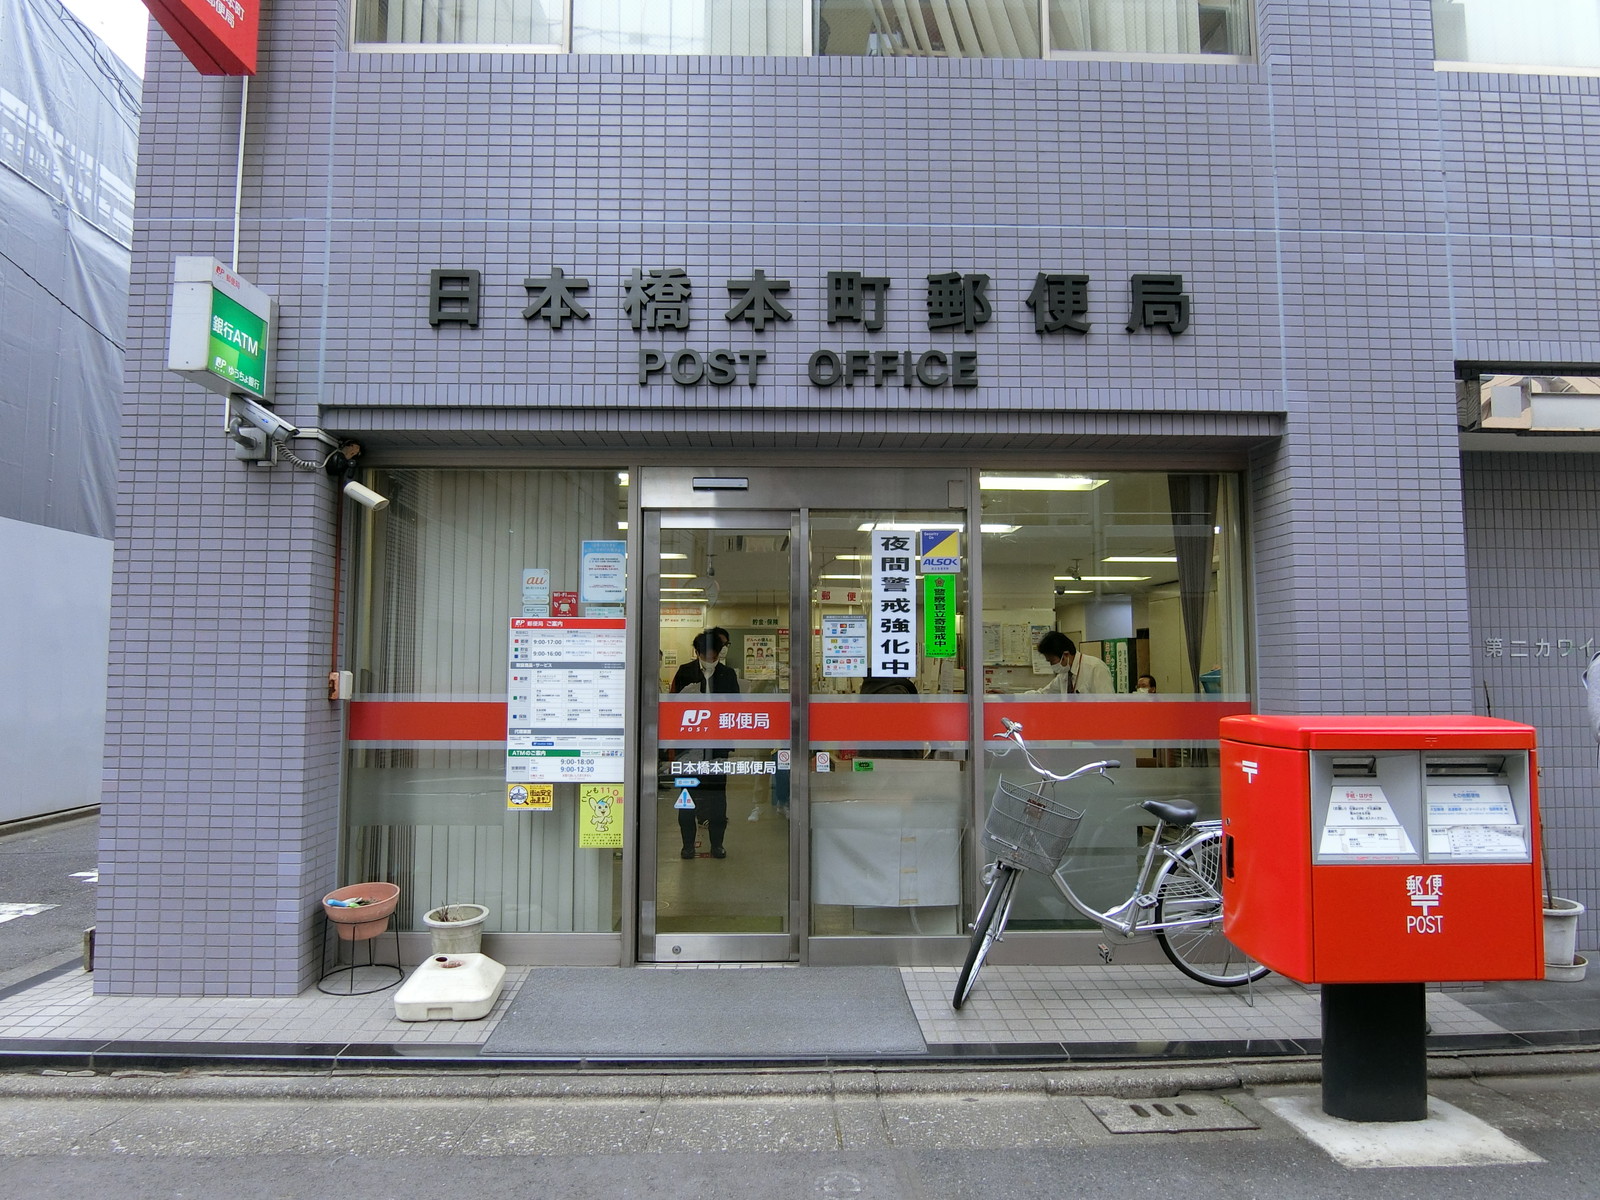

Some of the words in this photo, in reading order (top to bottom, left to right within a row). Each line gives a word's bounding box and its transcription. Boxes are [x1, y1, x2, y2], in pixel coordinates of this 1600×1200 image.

[429, 267, 1190, 335] 日本橋本町郵便局
[212, 315, 259, 357] 銀行ATM
[227, 364, 260, 391] ゆうちょ銀行
[639, 348, 767, 388] POST
[808, 349, 978, 388] OFFICE
[922, 558, 958, 567] ALSOK
[526, 576, 547, 585] au
[880, 535, 911, 675] 夜間警戒強化中
[752, 618, 779, 626] 貯金・保険
[718, 712, 770, 730] 郵便局
[670, 761, 777, 775] 日本橋本町郵便局
[1405, 874, 1443, 896] 郵便
[1406, 915, 1444, 934] POST
